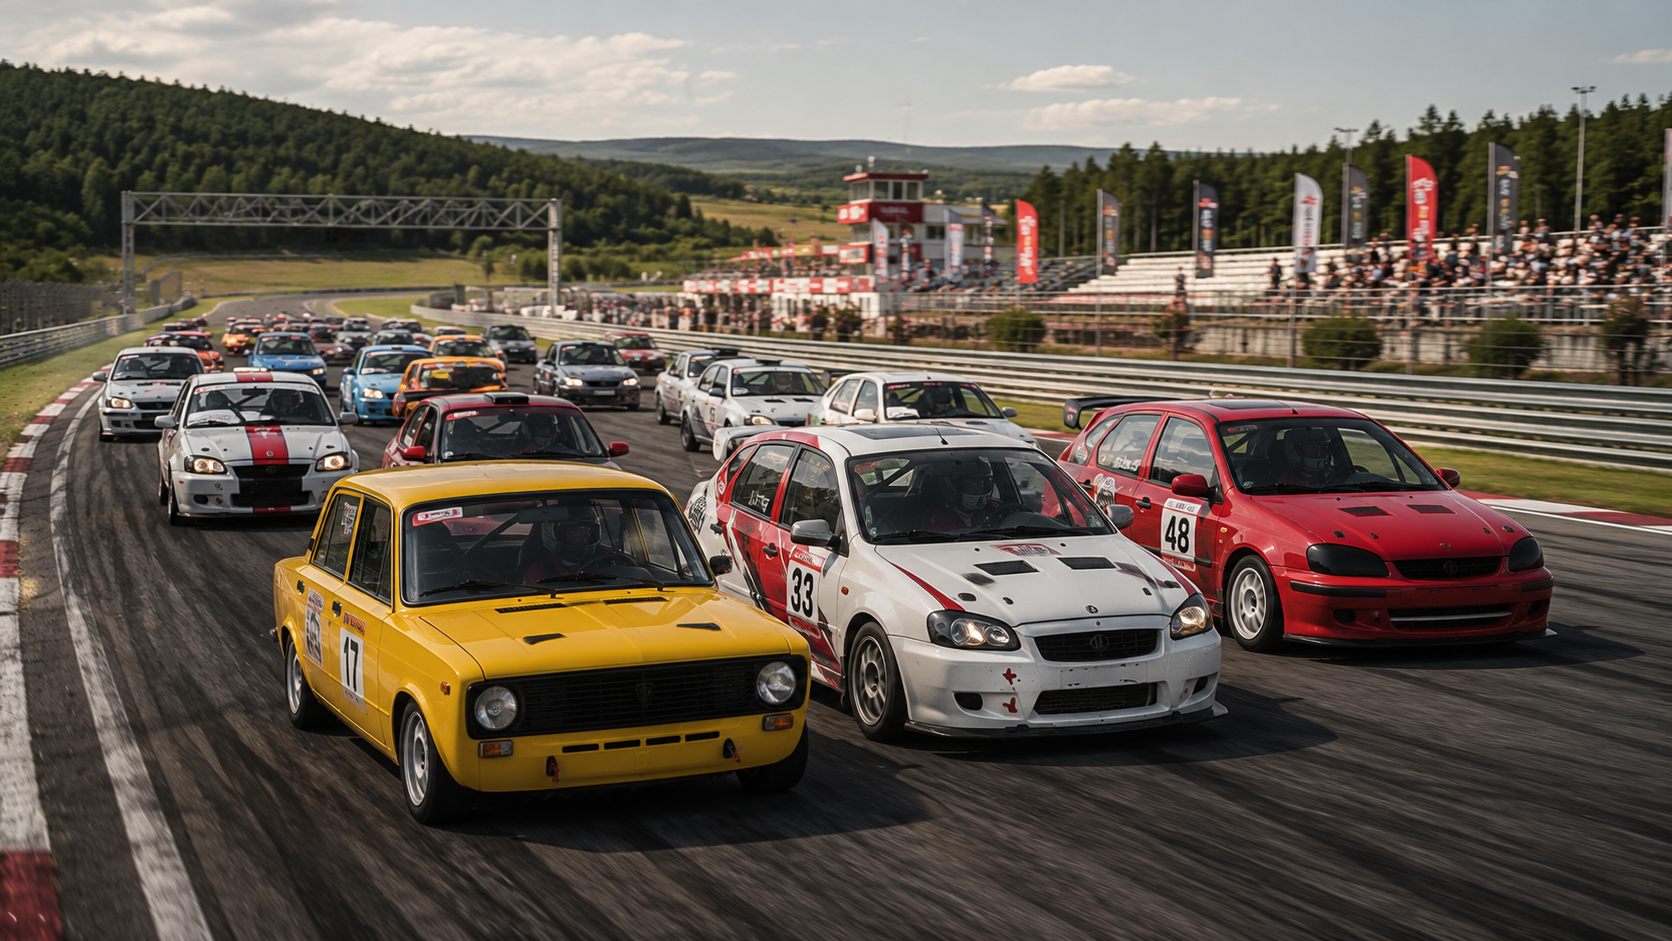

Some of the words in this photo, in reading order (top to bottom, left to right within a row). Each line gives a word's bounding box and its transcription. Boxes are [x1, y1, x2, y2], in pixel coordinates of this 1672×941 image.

[1165, 515, 1189, 553] 48
[791, 567, 813, 617] 33
[343, 636, 359, 692] 17
